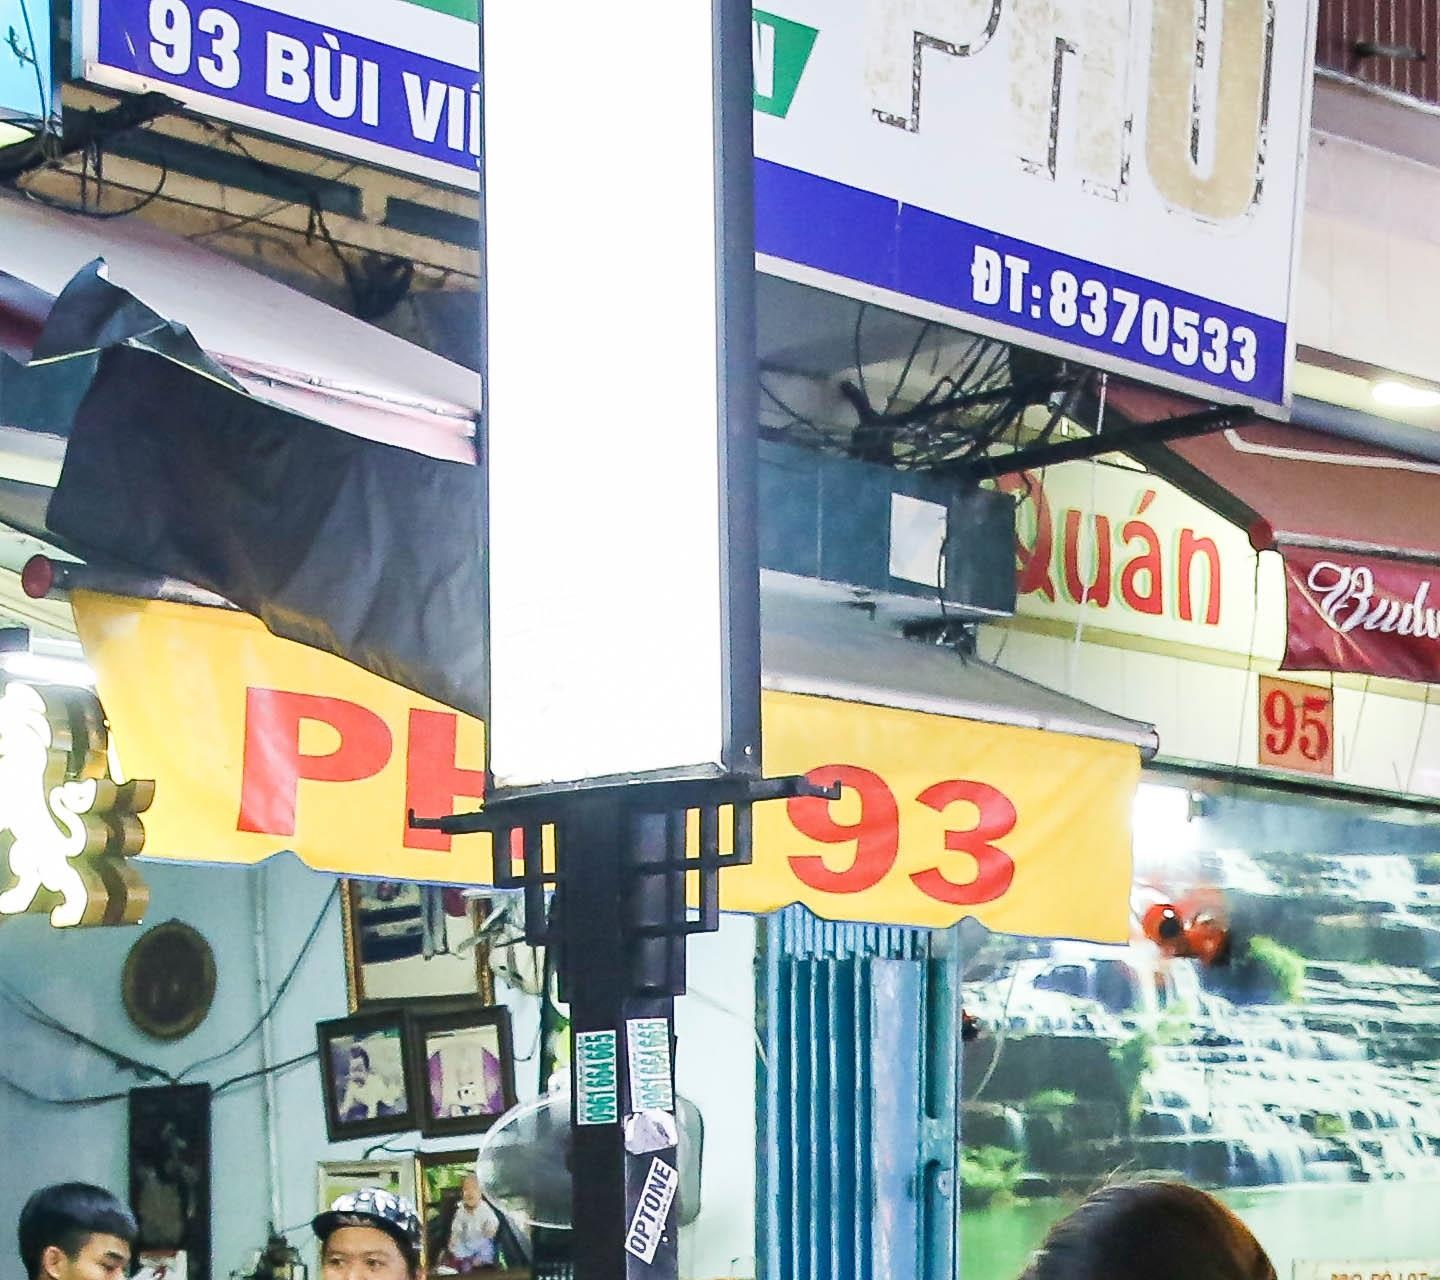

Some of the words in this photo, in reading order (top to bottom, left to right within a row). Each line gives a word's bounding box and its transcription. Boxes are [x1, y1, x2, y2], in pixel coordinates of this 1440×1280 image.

[148, 0, 241, 90] 93
[265, 31, 379, 128] BÙI
[969, 244, 1259, 384] ĐT:8370533
[997, 470, 1221, 626] Quán
[1263, 689, 1330, 761] 95
[786, 764, 1018, 906] 93
[630, 1161, 671, 1254] OPTONE
